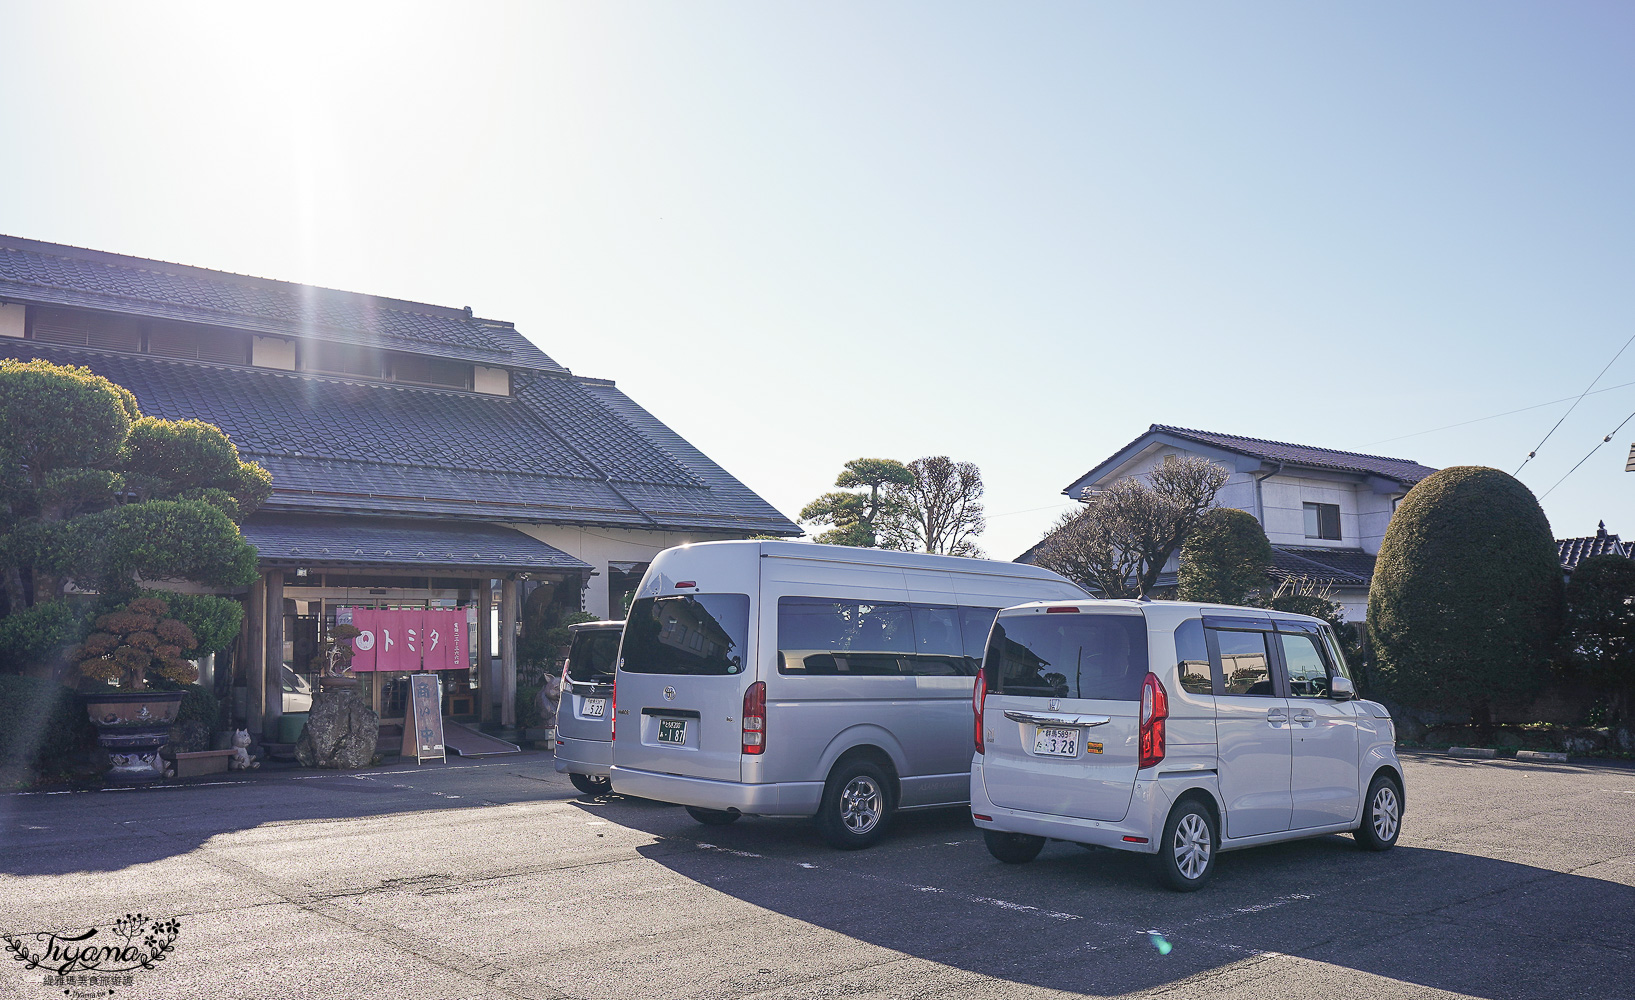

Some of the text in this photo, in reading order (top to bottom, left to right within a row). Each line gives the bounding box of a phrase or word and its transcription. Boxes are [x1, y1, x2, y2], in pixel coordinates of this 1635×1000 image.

[383, 629, 439, 652] トミタ
[417, 682, 434, 743] 商い中
